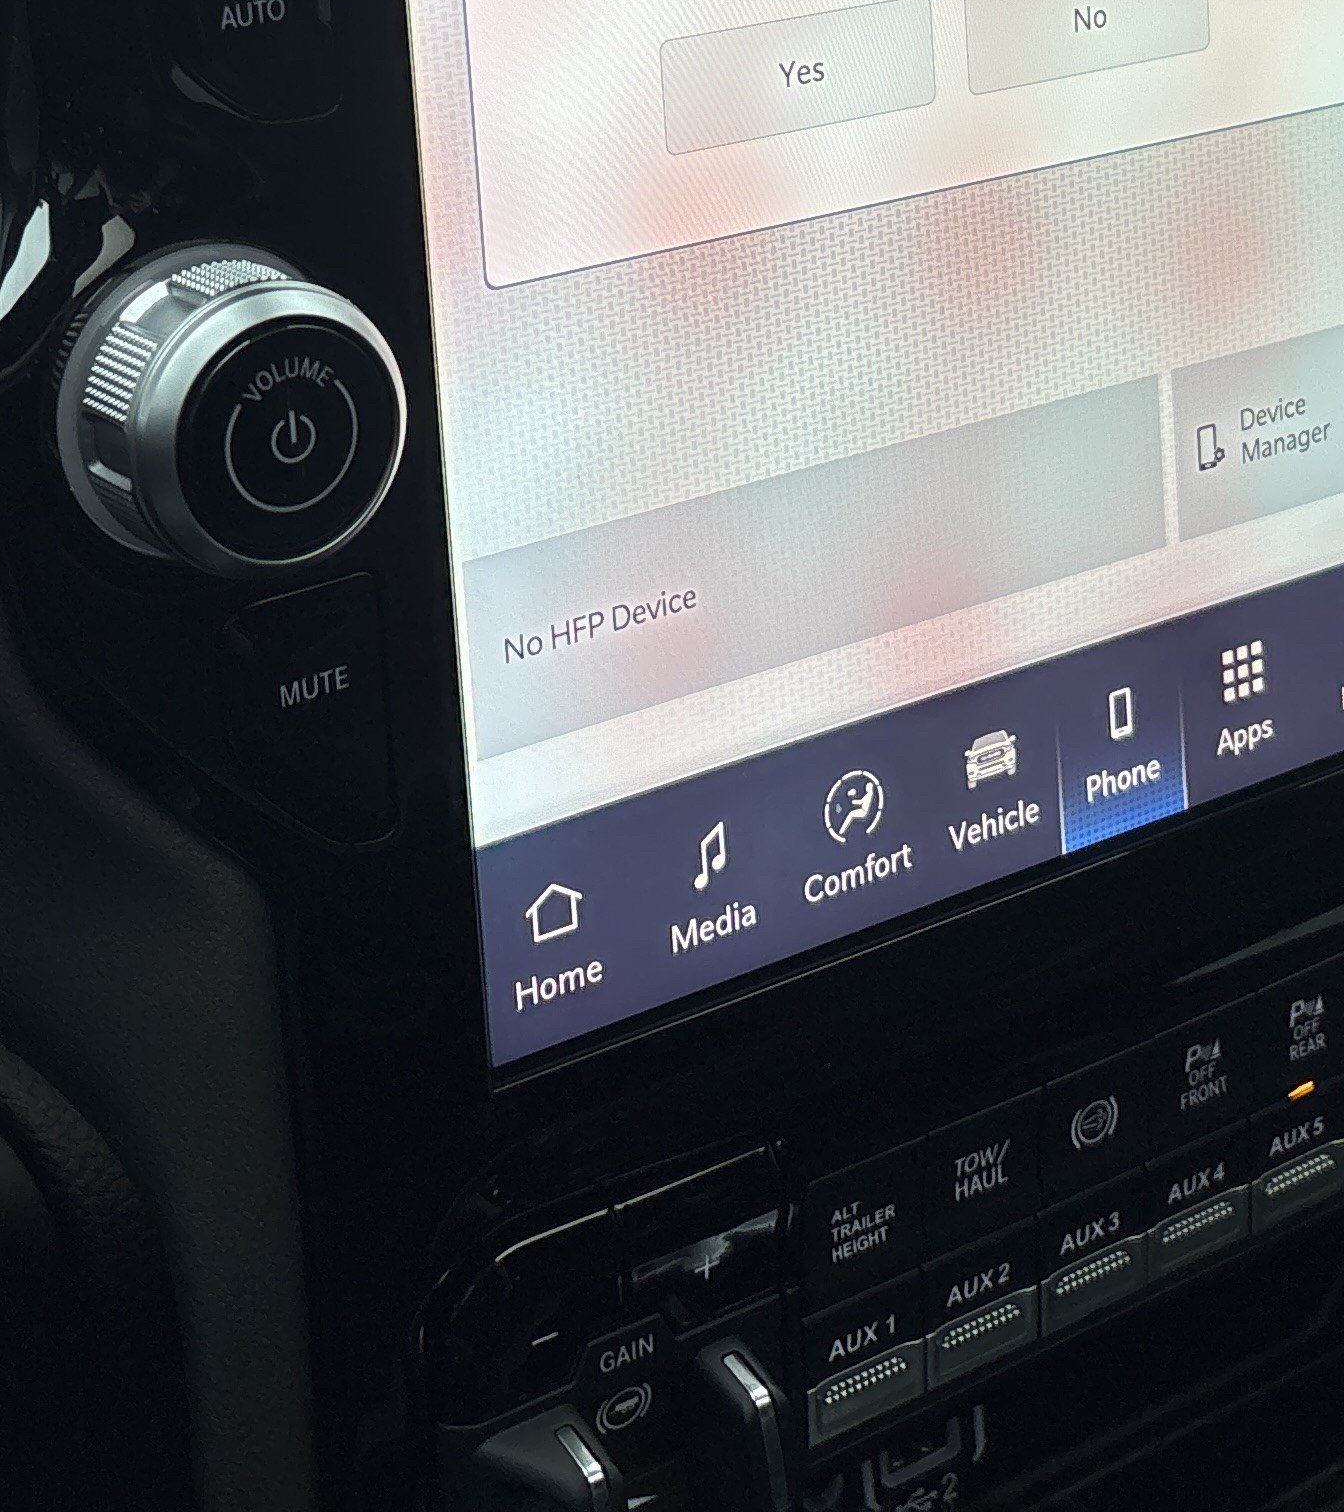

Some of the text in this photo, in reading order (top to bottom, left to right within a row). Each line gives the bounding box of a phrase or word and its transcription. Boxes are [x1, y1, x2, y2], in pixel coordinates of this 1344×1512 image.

[1072, 6, 1108, 33] No
[778, 60, 826, 89] Yes
[242, 355, 336, 403] VOLUME
[1239, 397, 1306, 431] Device
[1241, 422, 1331, 465] Manager
[504, 589, 698, 664] No HFP Device
[279, 665, 350, 709] MUTE
[1216, 716, 1274, 757] Apps
[1085, 758, 1162, 804] Phone
[948, 799, 1040, 851] Vehicle
[803, 843, 914, 905] Comfort
[670, 901, 758, 955] Media
[514, 959, 605, 1012] Home
[1289, 1033, 1328, 1063] REAR
[1293, 1016, 1320, 1041] OFF
[1180, 1075, 1228, 1111] FRONT
[1188, 1060, 1218, 1087] OFF
[1268, 1116, 1326, 1157] AUX 5
[954, 1139, 1011, 1178] TOW/
[955, 1164, 1008, 1201] HAUL
[1167, 1162, 1226, 1205] AUX 4
[831, 1202, 860, 1223] ALT
[831, 1204, 896, 1242] TRAILER
[831, 1225, 887, 1263] HEIGHT
[1058, 1212, 1121, 1256] AUX 3
[946, 1263, 1011, 1308] AUX 2
[599, 1334, 654, 1373] GAIN
[828, 1314, 896, 1362] AUX 1
